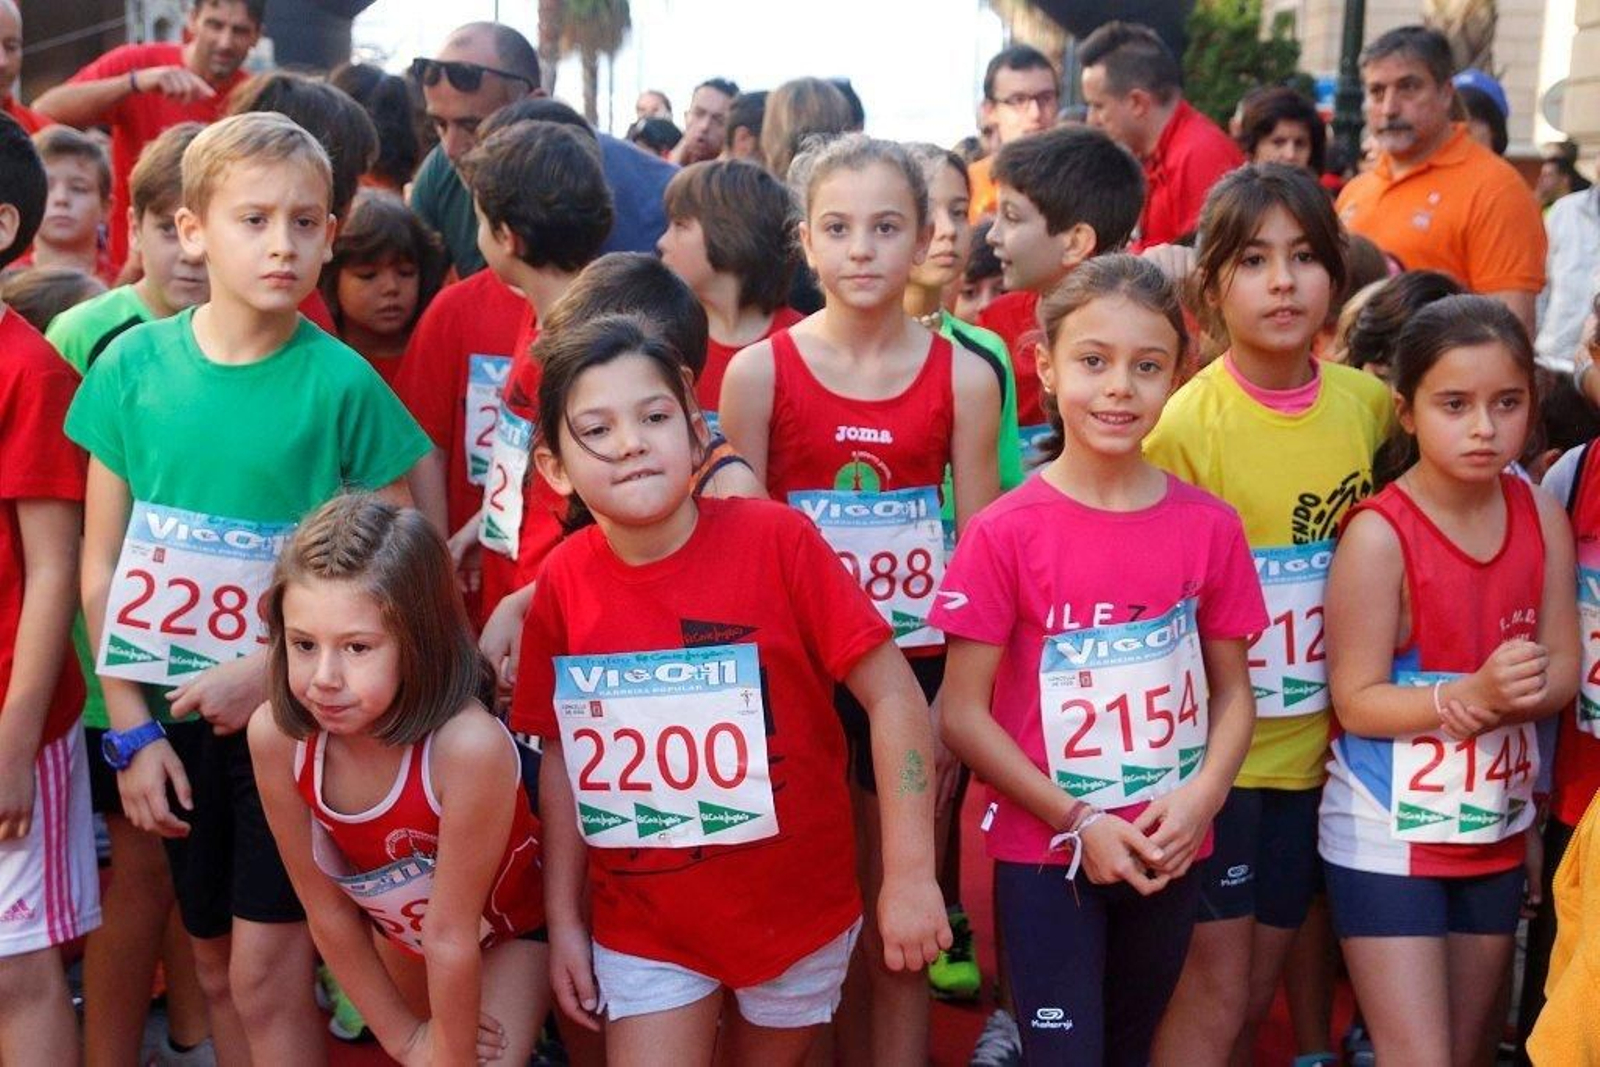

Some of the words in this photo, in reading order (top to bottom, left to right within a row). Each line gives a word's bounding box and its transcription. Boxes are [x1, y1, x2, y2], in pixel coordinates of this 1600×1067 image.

[1061, 669, 1199, 760] 2154
[573, 722, 748, 792] 2200
[1409, 728, 1532, 793] 2144
